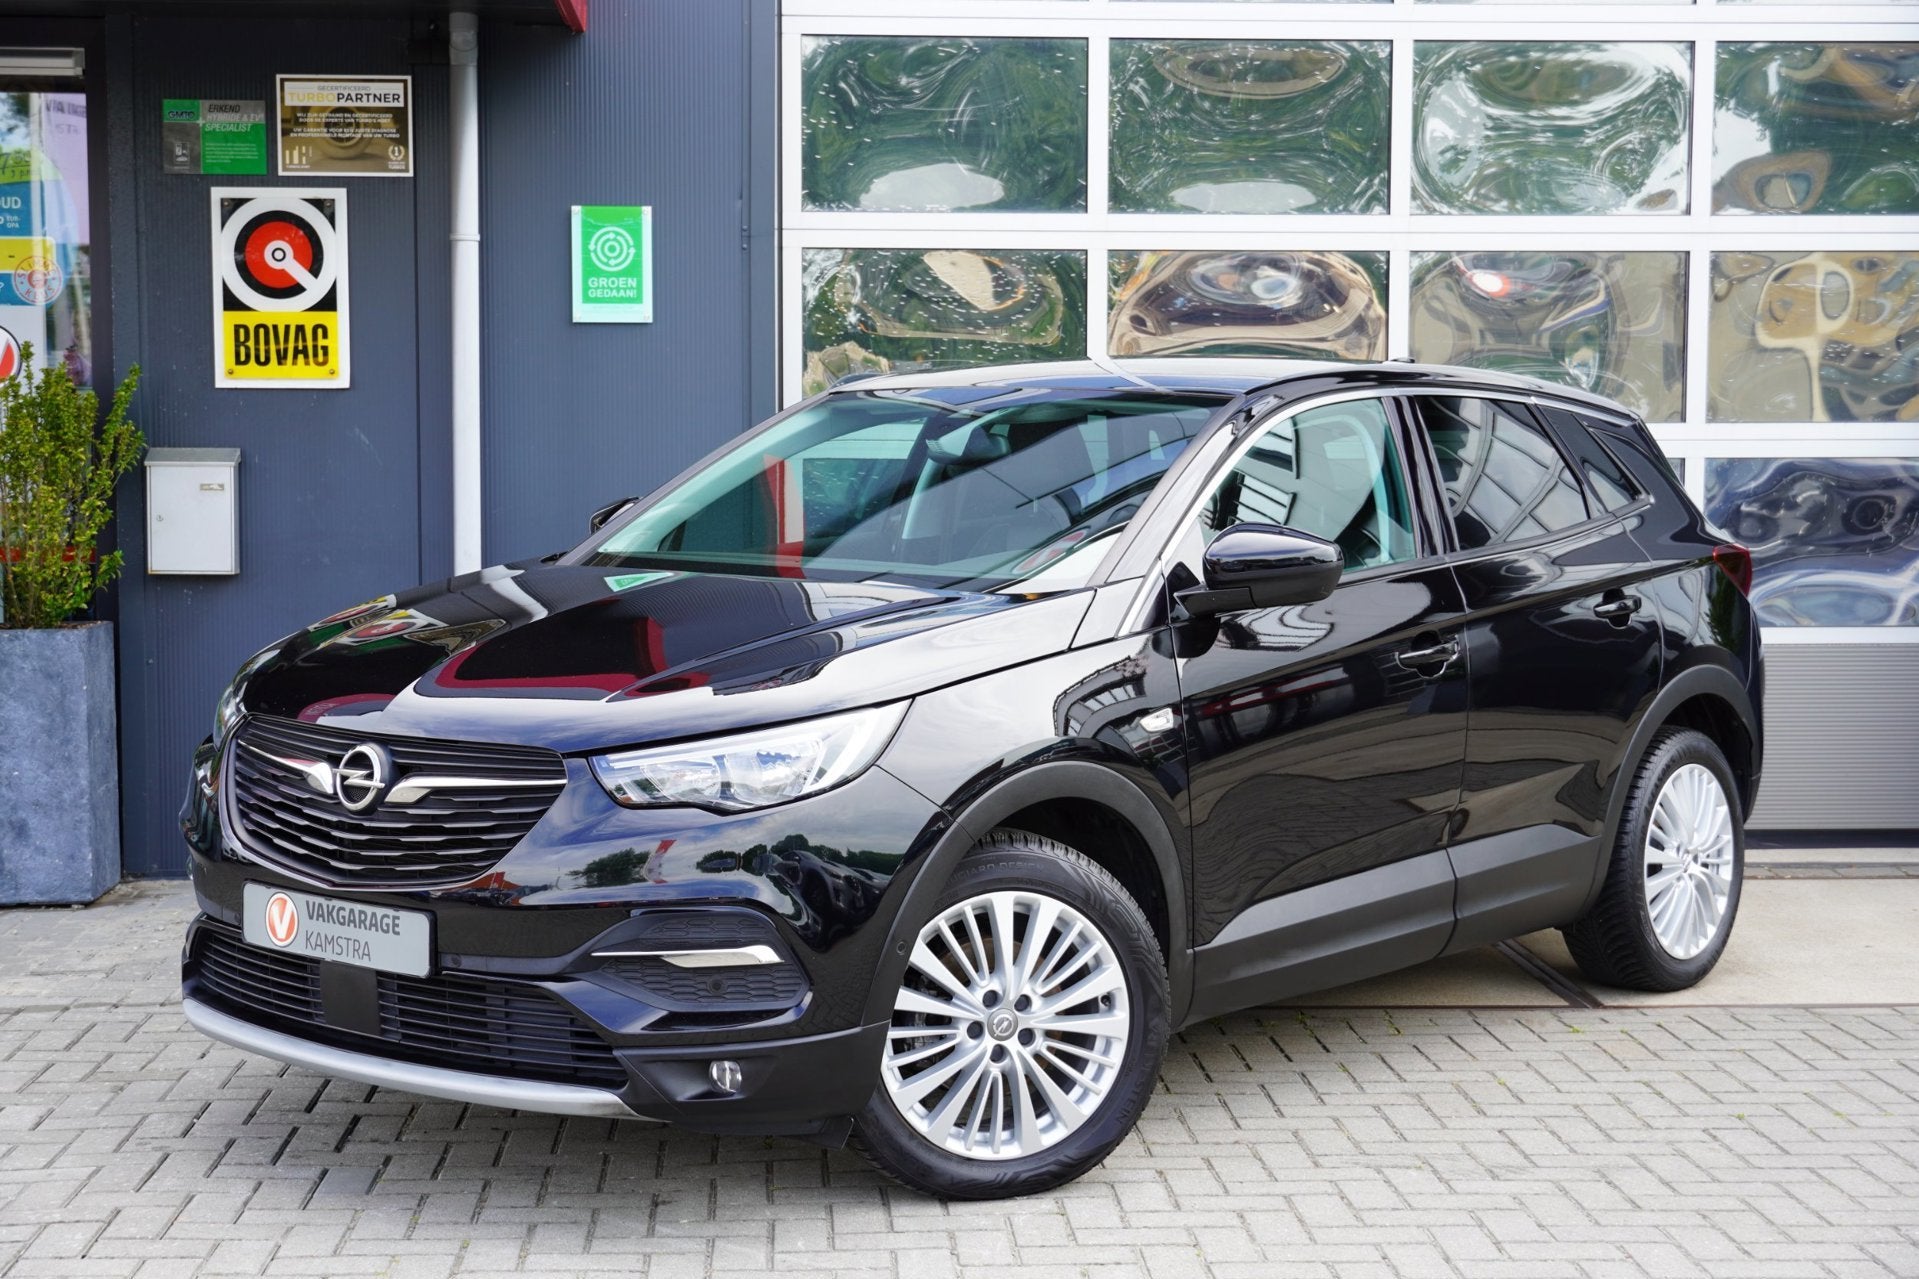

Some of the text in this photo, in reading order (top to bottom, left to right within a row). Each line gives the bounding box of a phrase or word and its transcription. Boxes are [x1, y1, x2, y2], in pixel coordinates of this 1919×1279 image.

[288, 92, 401, 103] TURBOPARTNER
[208, 104, 241, 113] ERKEND
[206, 112, 241, 121] HYBRIDE
[205, 123, 252, 132] SPECIALIST
[588, 277, 637, 288] GROEN
[588, 289, 637, 298] GEDAAN!
[233, 323, 329, 367] BOVAG
[306, 900, 400, 936] VAKGARAGE
[305, 930, 371, 961] KAMSTRA
